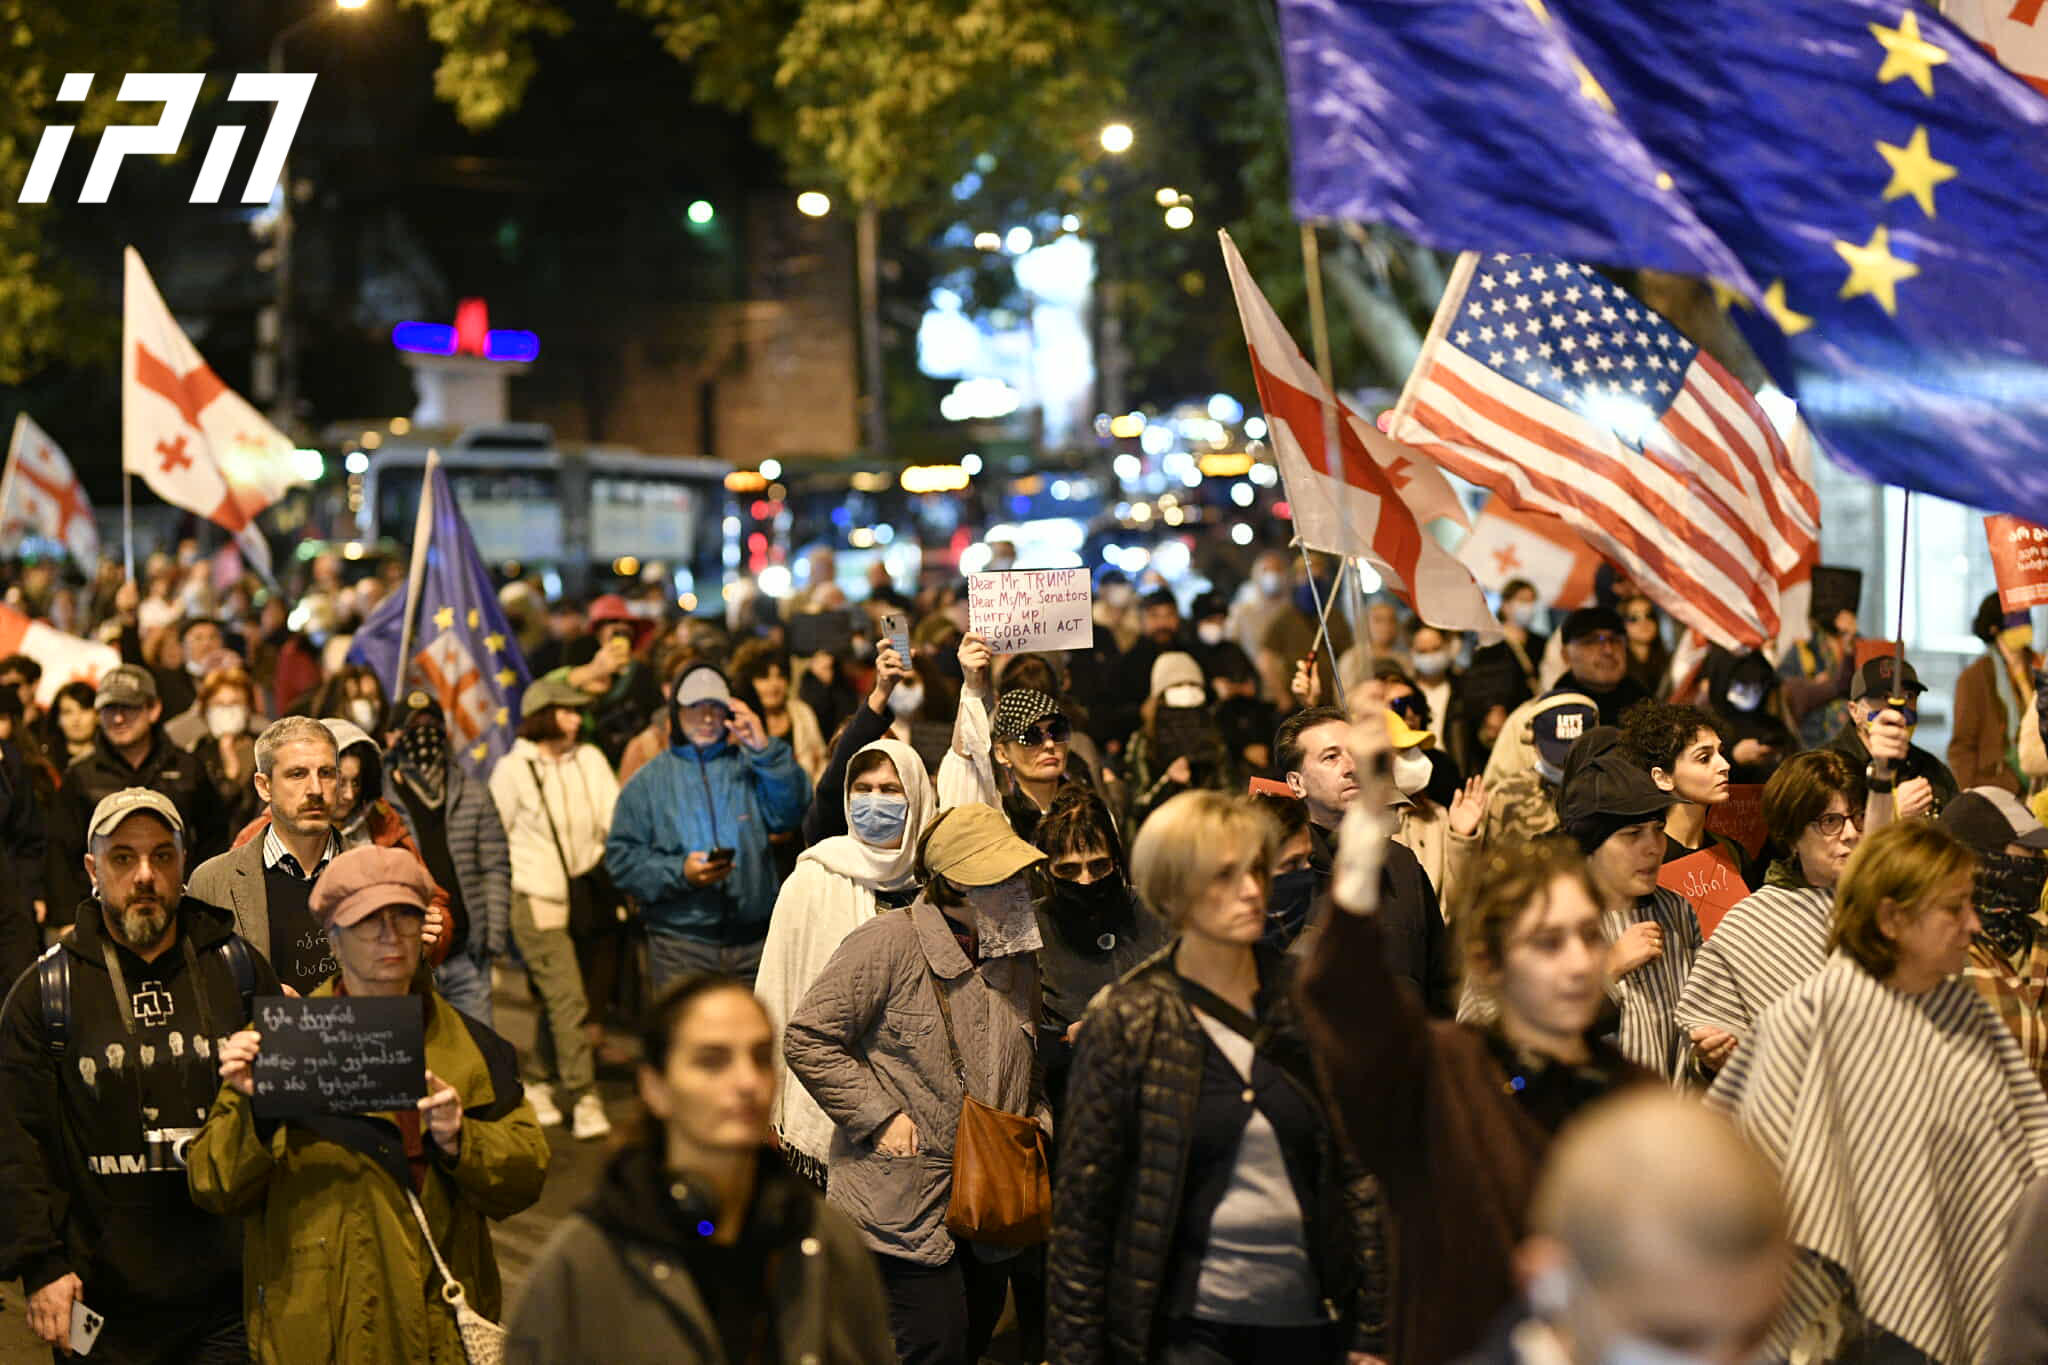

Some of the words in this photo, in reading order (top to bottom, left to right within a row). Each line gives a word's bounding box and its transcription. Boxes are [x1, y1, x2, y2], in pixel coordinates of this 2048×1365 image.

[970, 575, 996, 591] Dear
[1001, 571, 1020, 590] Mr
[1024, 570, 1076, 591] TRUMP
[970, 594, 994, 609] Dear
[1040, 590, 1088, 604] Senators
[975, 622, 1047, 639] MEGOBARI
[1057, 618, 1083, 633] ACT
